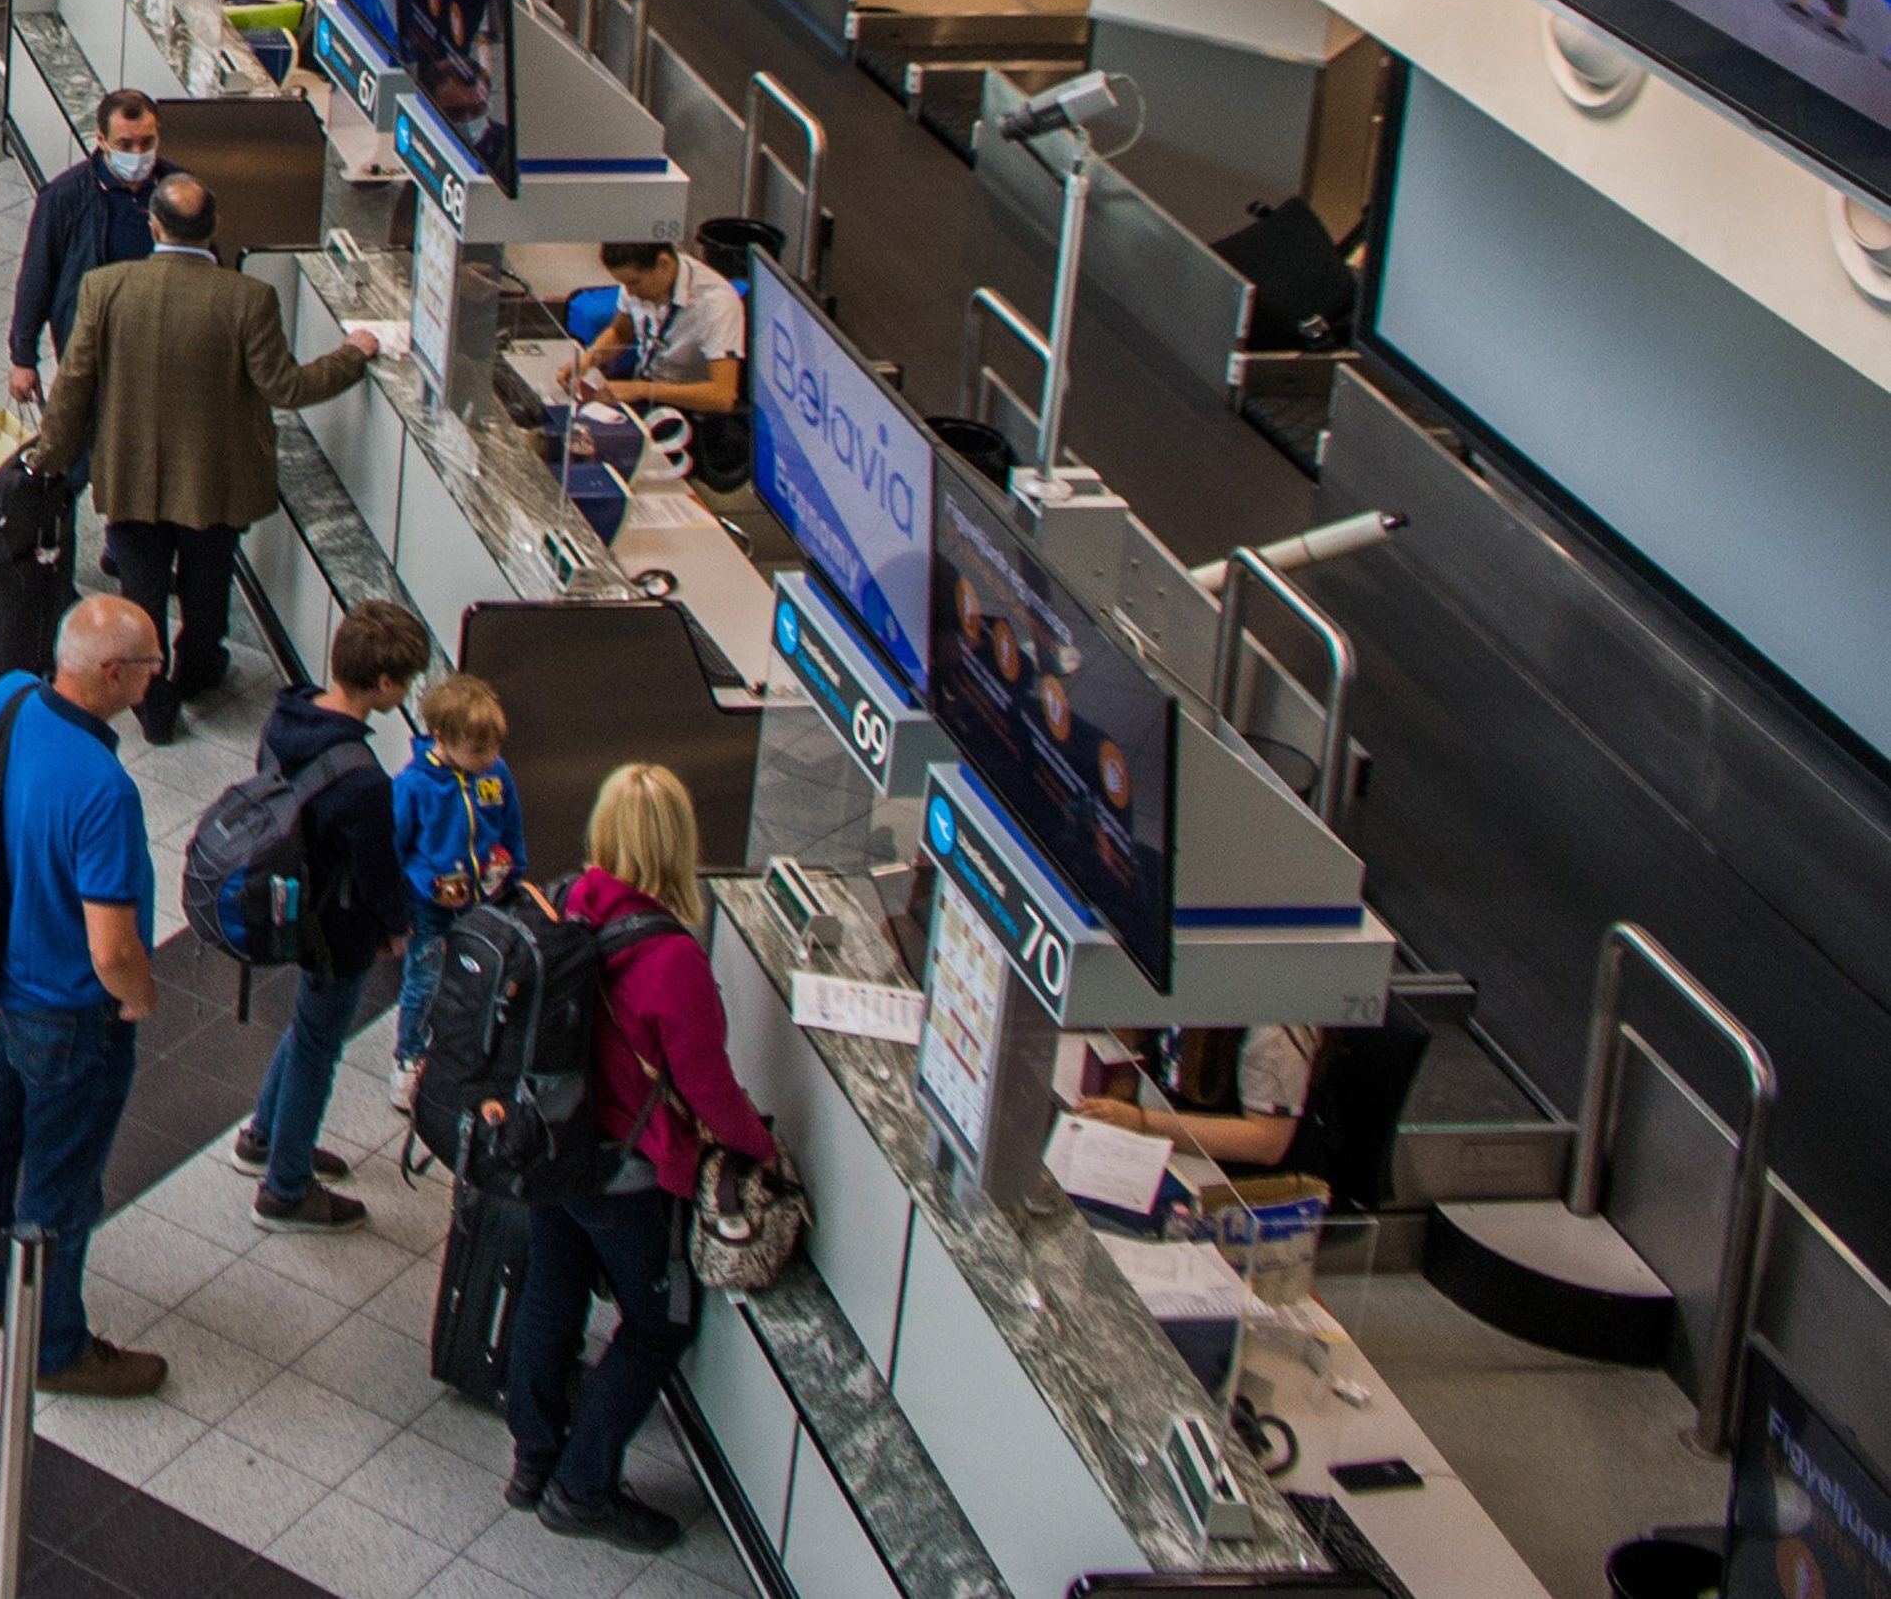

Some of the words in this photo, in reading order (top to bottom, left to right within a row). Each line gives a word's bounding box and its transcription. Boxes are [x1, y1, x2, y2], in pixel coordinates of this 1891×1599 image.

[358, 67, 377, 113] 67
[442, 171, 463, 227] 68
[651, 219, 681, 241] 68
[772, 316, 915, 542] Belavia
[773, 450, 862, 594] Economy
[851, 699, 888, 767] 69
[1020, 901, 1066, 998] 70
[1343, 996, 1382, 1022] 70
